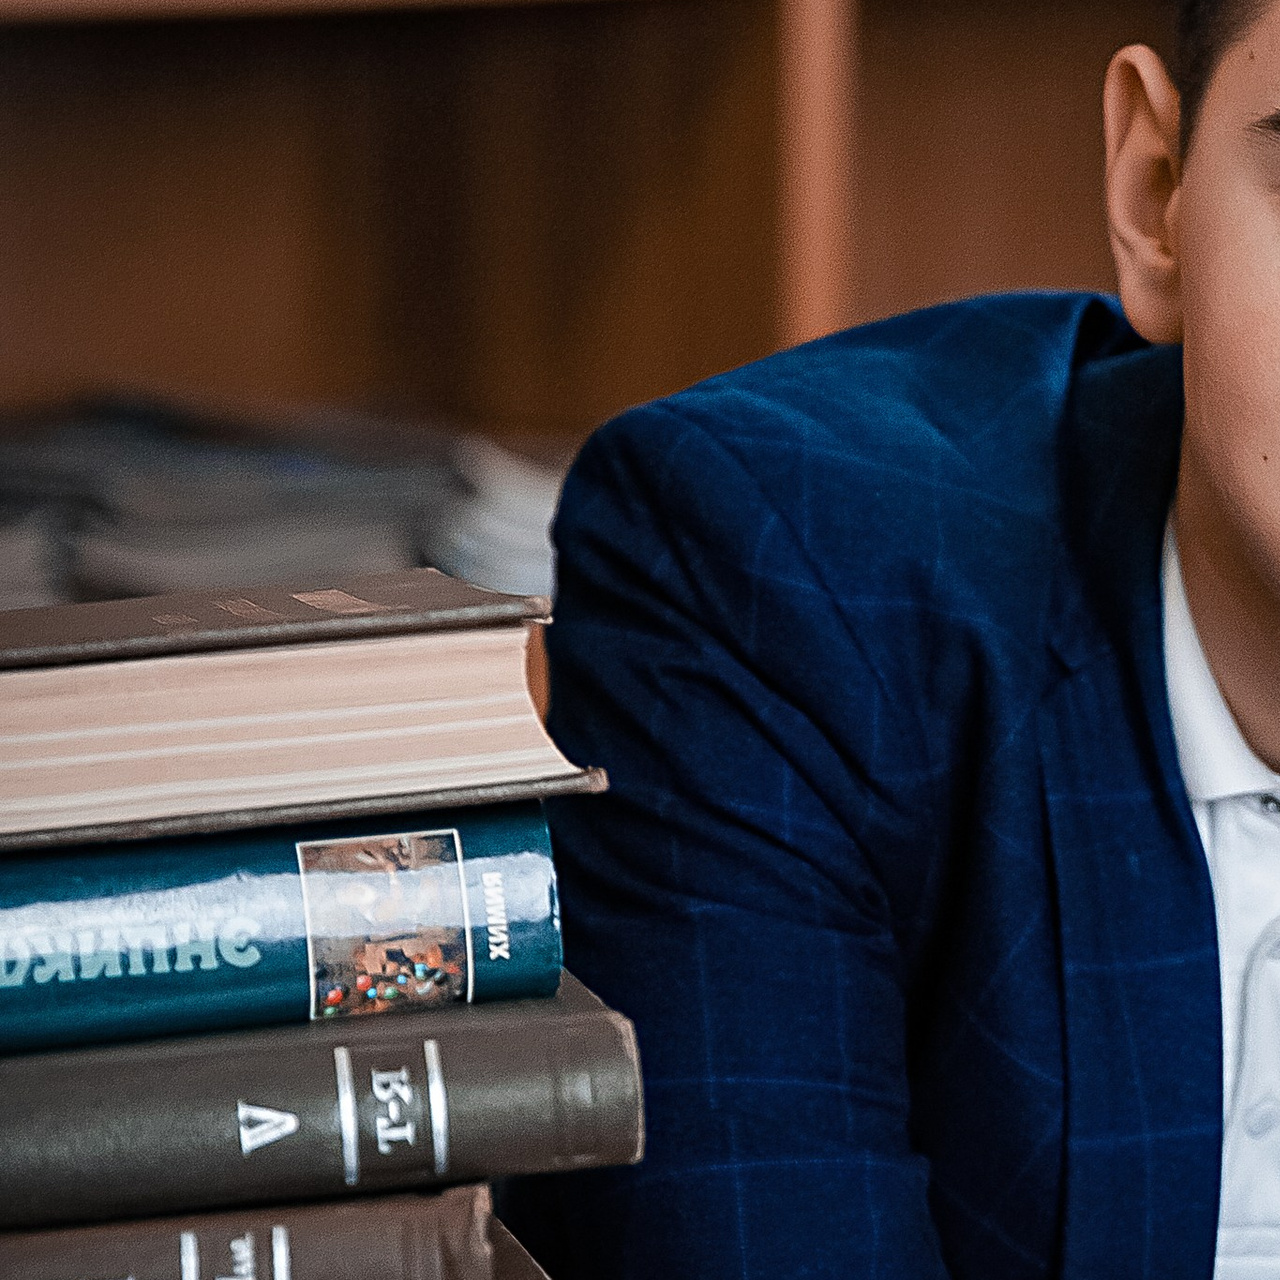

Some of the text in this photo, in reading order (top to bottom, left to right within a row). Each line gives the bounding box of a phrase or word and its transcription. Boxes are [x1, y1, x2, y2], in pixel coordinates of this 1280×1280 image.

[481, 870, 511, 962] ХИМИЯ
[236, 1098, 299, 1156] V
[370, 1066, 417, 1155] Т-Я
